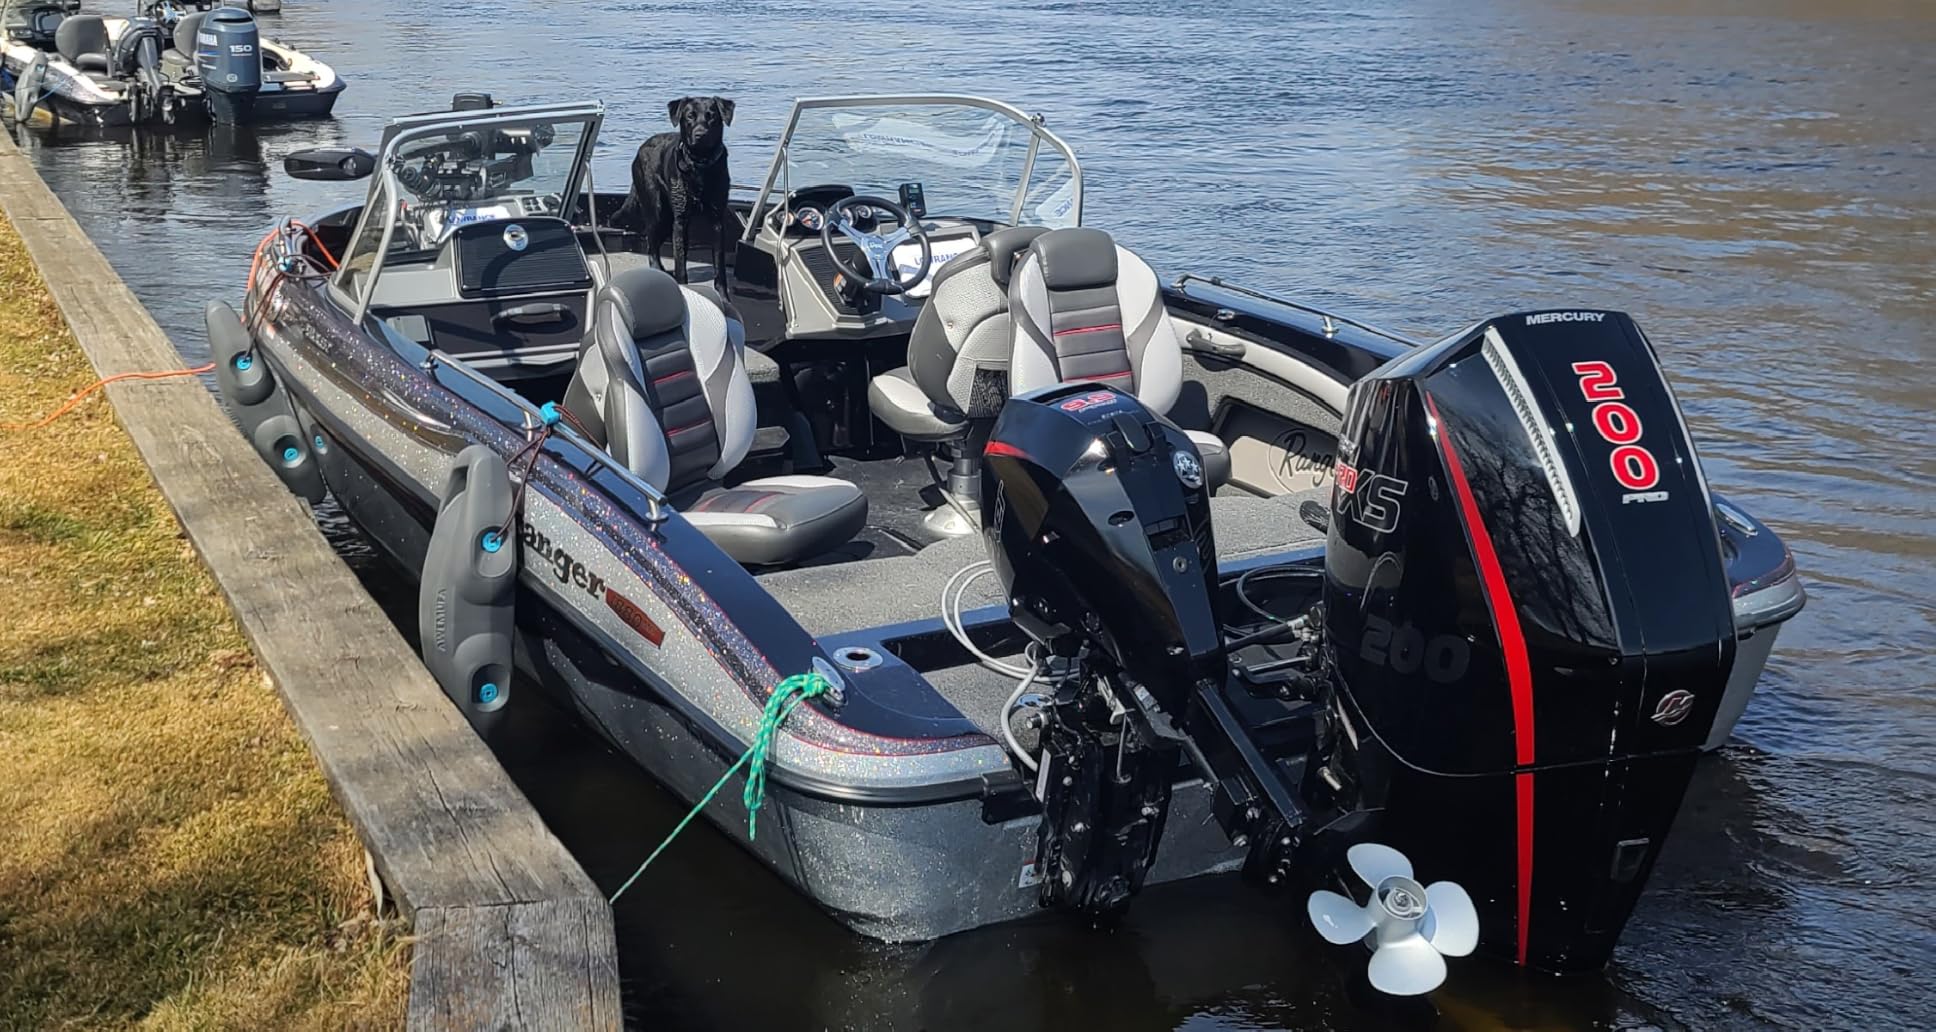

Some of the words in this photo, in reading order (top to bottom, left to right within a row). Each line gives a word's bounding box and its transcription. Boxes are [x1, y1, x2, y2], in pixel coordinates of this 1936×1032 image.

[229, 44, 253, 53] 150
[1526, 312, 1606, 325] MERCURY
[1571, 360, 1660, 490] 200
[1622, 491, 1670, 504] PRO
[522, 522, 606, 600] anger
[1359, 613, 1470, 684] 200
